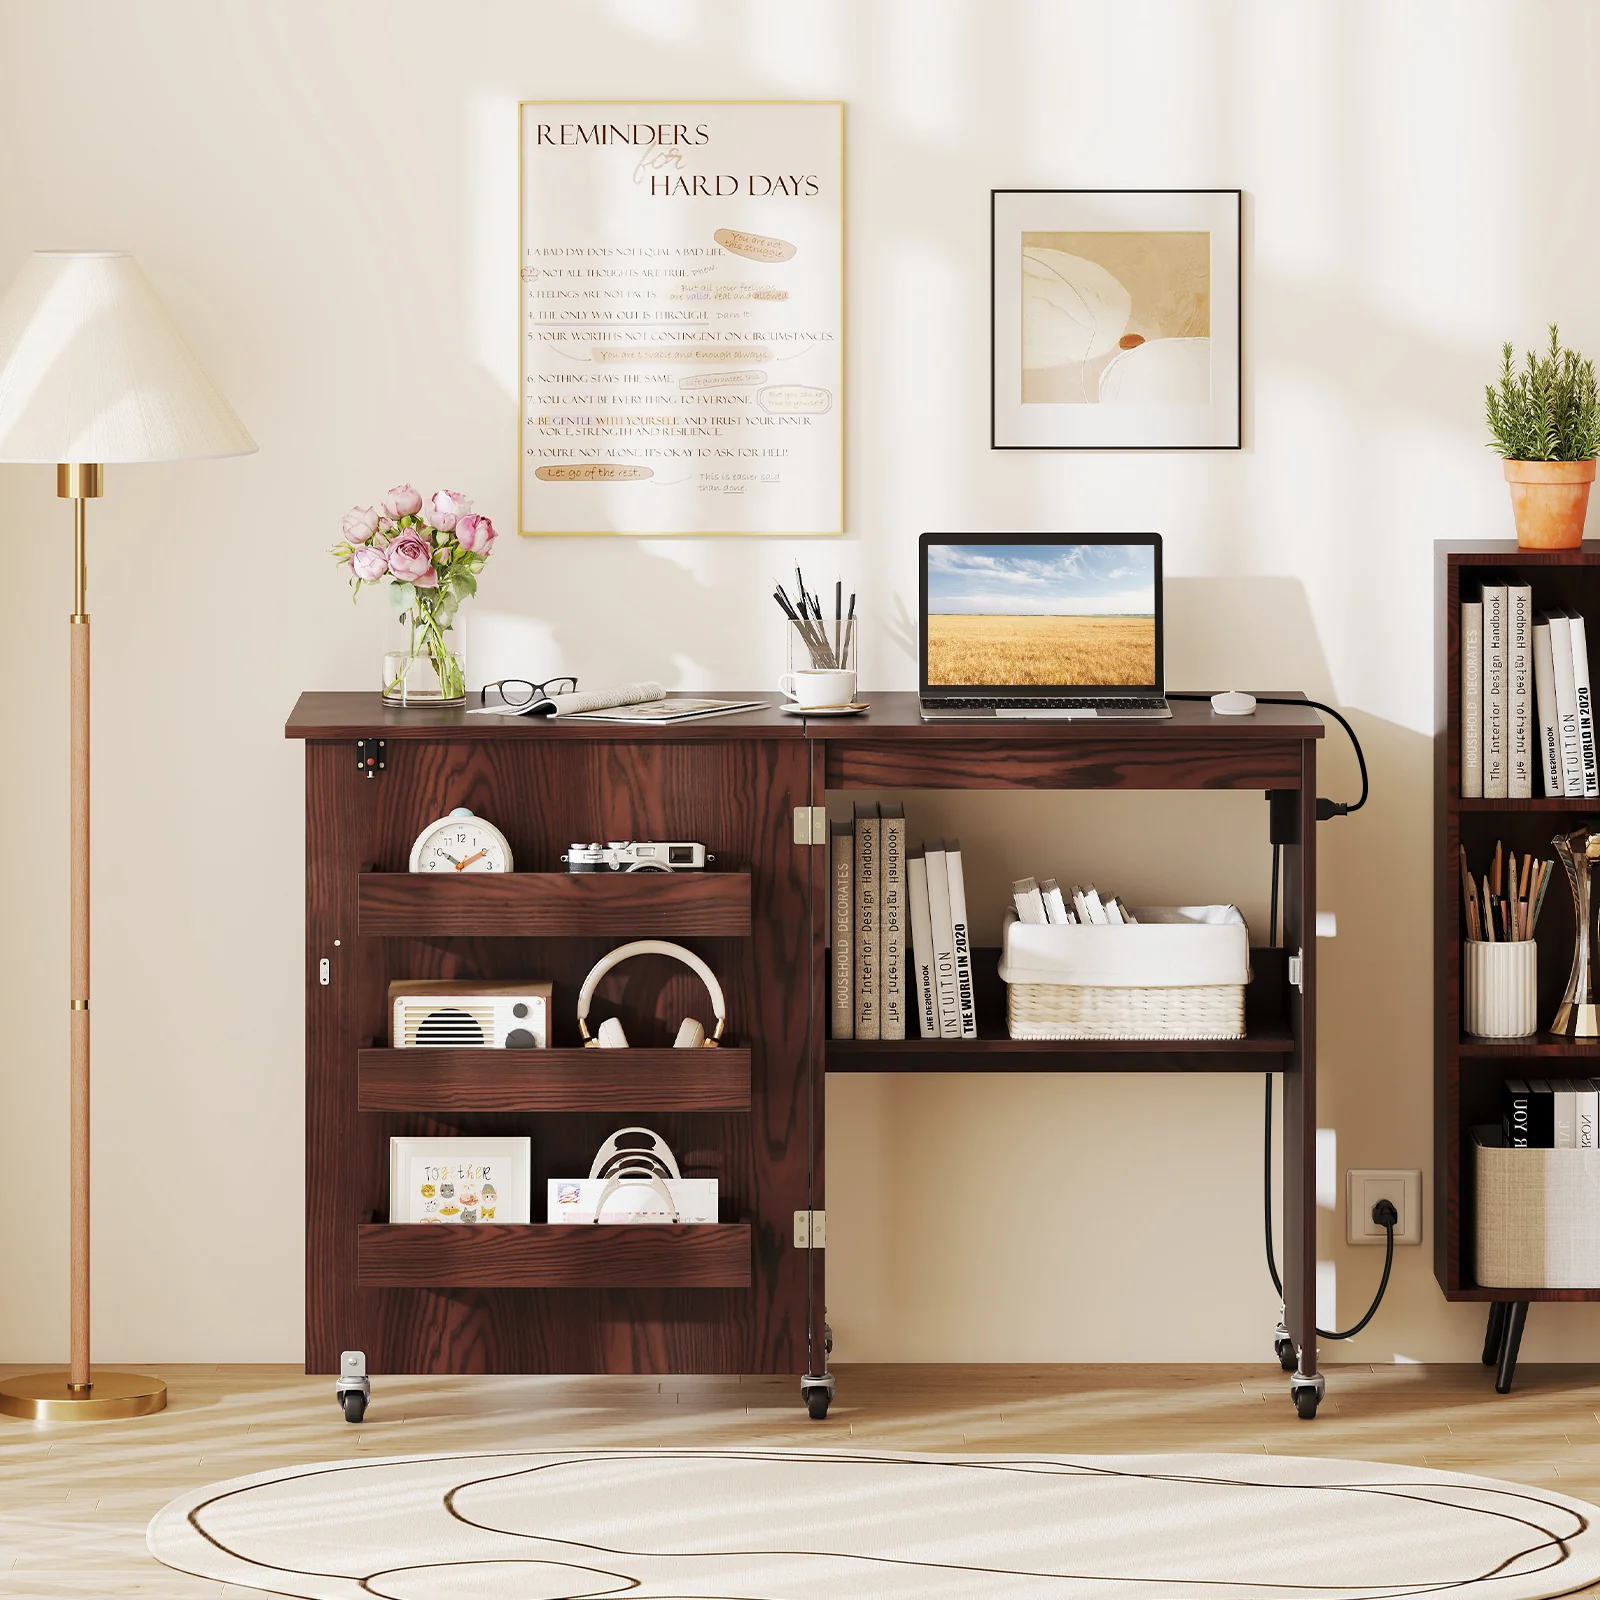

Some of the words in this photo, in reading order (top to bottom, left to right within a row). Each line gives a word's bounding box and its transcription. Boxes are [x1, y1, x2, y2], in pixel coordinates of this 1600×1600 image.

[537, 124, 709, 145] REMINDERS
[632, 141, 686, 185] for
[651, 175, 739, 196] HARD
[748, 175, 819, 196] DAYS
[732, 232, 749, 243] You
[543, 248, 564, 257] BAD
[566, 248, 585, 257] DAY
[587, 248, 614, 257] DOES
[615, 248, 636, 257] NOT
[683, 248, 704, 257] BAD
[542, 269, 563, 278] NOT
[566, 269, 582, 278] ALL
[586, 269, 639, 278] THOUGHTS
[641, 269, 660, 278] ARE
[537, 290, 580, 299] FEELINGS
[581, 290, 600, 299] ARE
[538, 311, 558, 320] THE
[560, 311, 589, 320] ONLY
[591, 311, 613, 320] WAY
[616, 311, 640, 320] OUT
[642, 311, 651, 320] IS
[527, 332, 536, 341] 5.
[537, 332, 568, 341] YOUR
[570, 332, 611, 341] WORTH
[613, 332, 623, 341] IS
[625, 332, 646, 341] NOT
[650, 332, 721, 341] CONTINGENT
[724, 332, 742, 341] ON
[674, 350, 693, 359] and
[538, 374, 588, 383] NOTHING
[590, 374, 620, 383] STAYS
[623, 374, 641, 383] THE
[537, 395, 560, 404] YOU
[597, 395, 609, 404] BE
[612, 395, 677, 404] EVERYTHING
[680, 395, 696, 404] TO
[537, 416, 552, 426] BE
[552, 416, 592, 426] GENTLE
[595, 416, 625, 426] WITH
[682, 416, 707, 426] AND
[709, 416, 742, 426] TRUST
[745, 416, 775, 426] YOUR
[778, 416, 812, 426] INNER
[575, 427, 633, 437] STRENGTH
[634, 427, 660, 437] AND
[578, 448, 602, 458] NOT
[663, 448, 694, 458] OKAY
[696, 448, 712, 458] TO
[713, 448, 735, 458] ASK
[737, 448, 759, 458] FOR
[547, 468, 566, 477] Let
[568, 469, 582, 480] go
[584, 466, 597, 480] of
[598, 468, 615, 477] the
[618, 468, 641, 477] rest.
[699, 472, 719, 481] This
[721, 472, 730, 481] is
[731, 472, 759, 481] easier
[760, 472, 781, 481] said
[698, 484, 721, 492] than
[1489, 595, 1500, 649] Handbook
[1466, 629, 1478, 695] DECORATES
[1489, 654, 1503, 695] Design
[1577, 687, 1590, 716] 2020
[1489, 701, 1500, 754] Interior
[1580, 717, 1590, 729] IN
[1466, 702, 1478, 768] HOUSEHOLD
[1562, 714, 1581, 792] INTUITION
[1581, 731, 1595, 771] WORLD
[1489, 760, 1500, 782] The
[1585, 772, 1596, 792] THE
[443, 837, 453, 847] 11
[456, 833, 467, 843] 12
[472, 837, 477, 847] 1
[433, 847, 443, 857] 10
[861, 827, 872, 884] Handbook
[429, 860, 436, 871] 9
[486, 860, 493, 871] 3
[837, 862, 849, 933] DECORATES
[861, 889, 874, 932] Design
[954, 923, 967, 954] 2020
[861, 939, 872, 995] Interior
[956, 955, 968, 968] IN
[837, 939, 849, 1010] HOUSEHOLD
[938, 951, 958, 1034] INTUITION
[958, 970, 972, 1011] WORLD
[861, 1001, 872, 1024] The
[962, 1012, 974, 1034] THE
